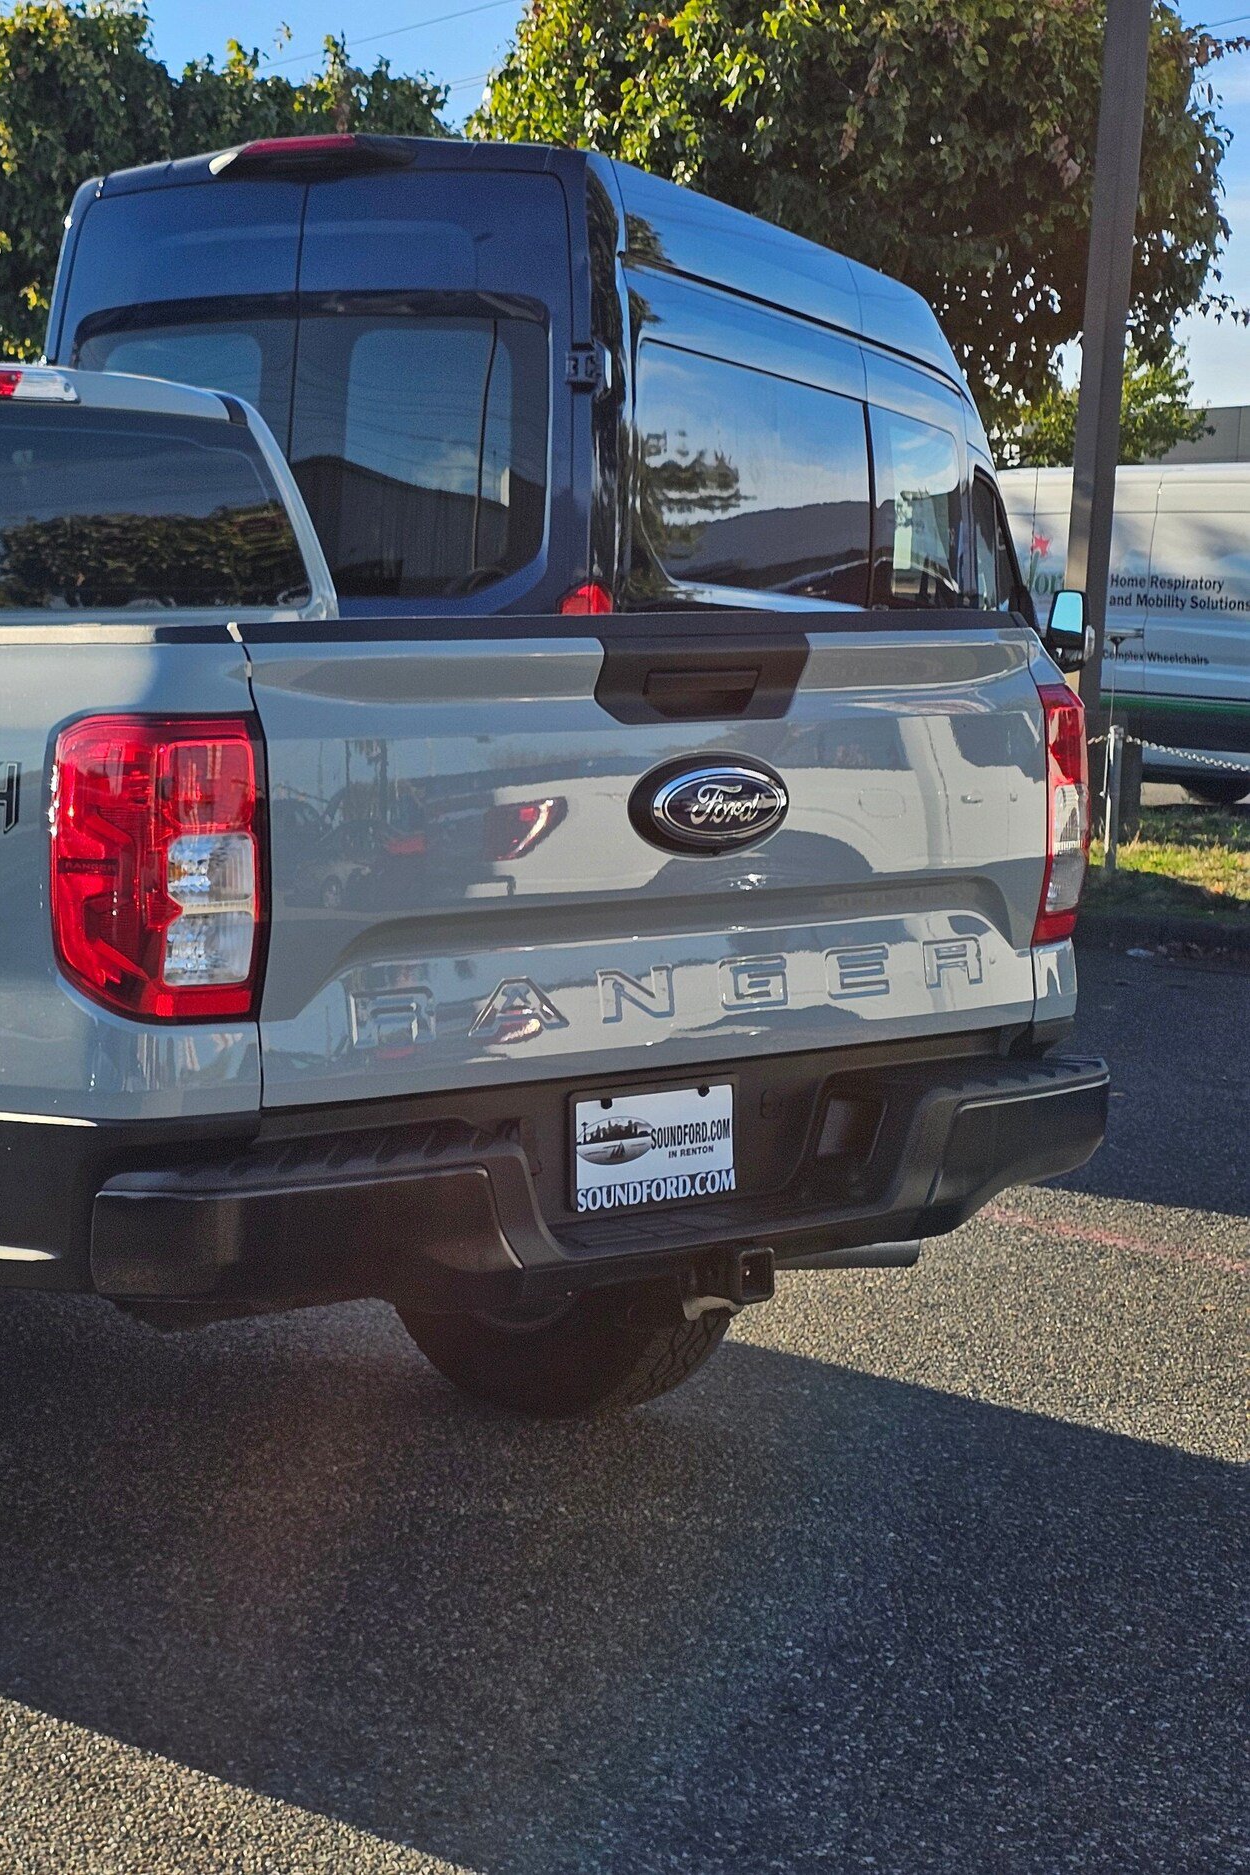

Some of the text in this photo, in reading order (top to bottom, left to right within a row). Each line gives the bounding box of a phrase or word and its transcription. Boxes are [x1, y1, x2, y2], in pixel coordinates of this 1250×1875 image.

[1110, 574, 1224, 594] Home Respiratory
[1109, 593, 1250, 611] and Mobility Solutions
[1147, 651, 1210, 666] Wheelchairs
[690, 784, 760, 825] Ford
[350, 935, 983, 1048] RANGER
[650, 1118, 731, 1150] SOUNDFORD.COM
[668, 1145, 715, 1159] IN RENTON
[577, 1168, 737, 1213] SOUNDFORD.COM
